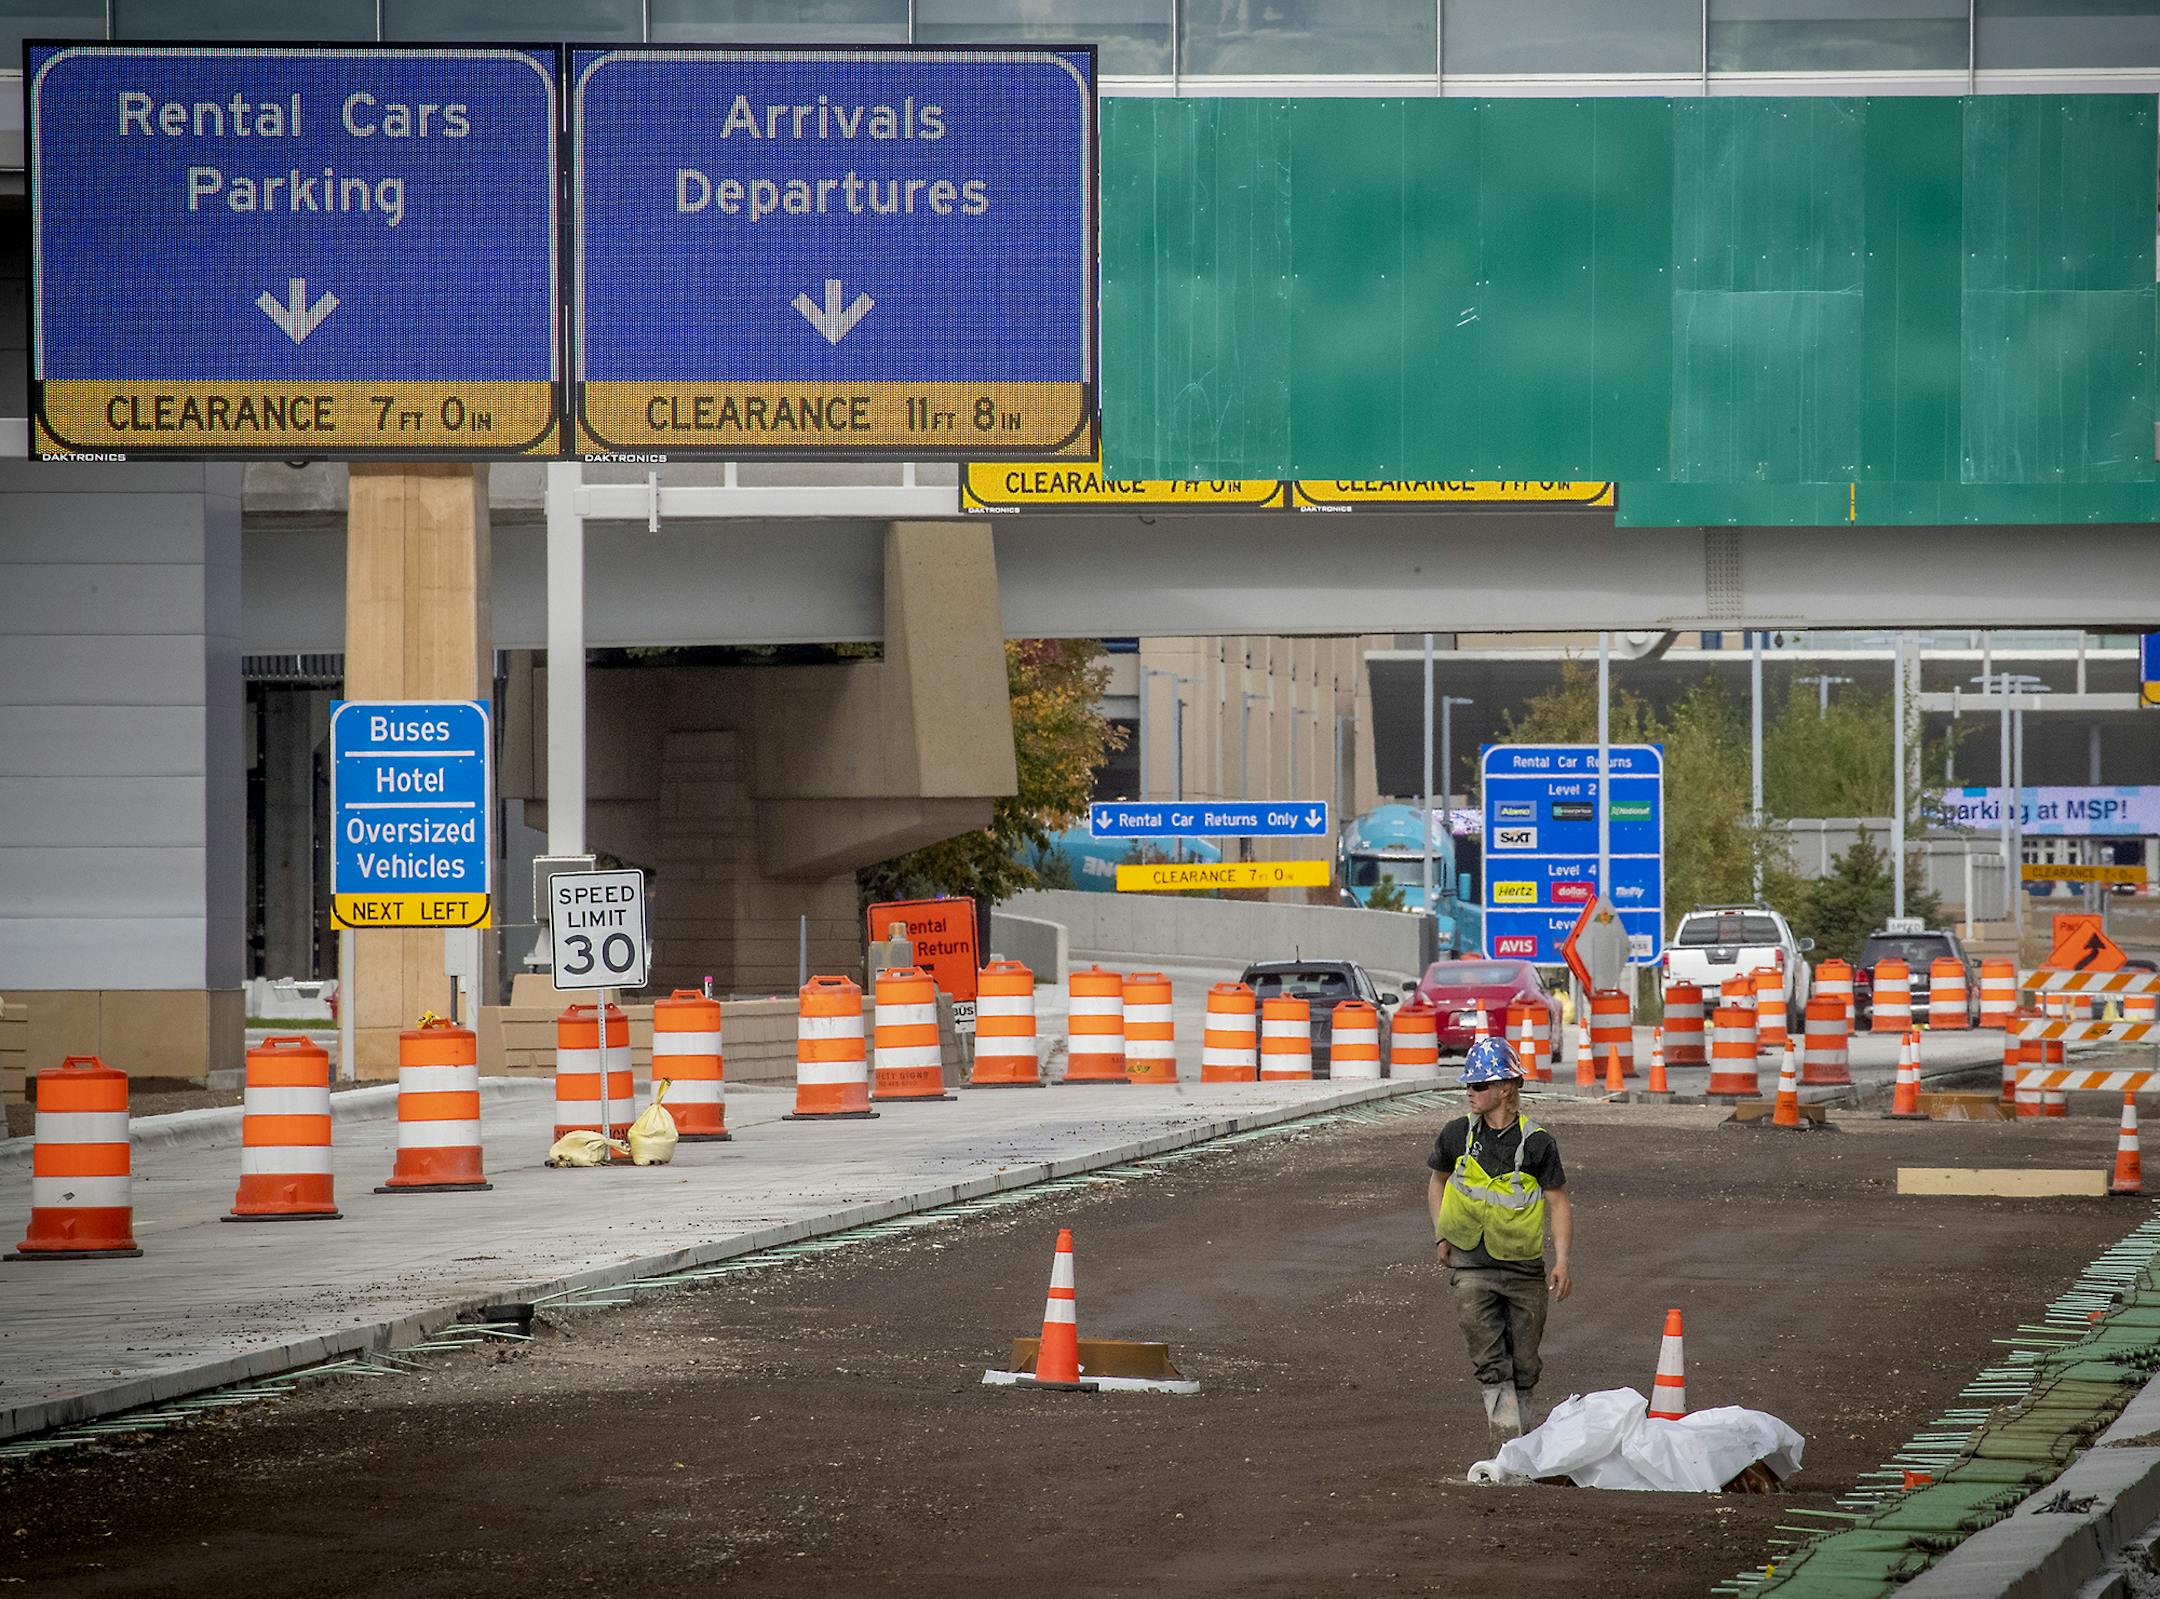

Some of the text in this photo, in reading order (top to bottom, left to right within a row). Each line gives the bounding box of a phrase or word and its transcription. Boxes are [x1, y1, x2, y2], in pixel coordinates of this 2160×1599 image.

[119, 91, 471, 138] Rental Cars
[720, 94, 946, 140] Arrivals
[187, 166, 405, 227] Parking
[675, 167, 989, 222] Departures
[106, 395, 334, 432] CLEARANCE
[646, 396, 870, 431] CLEARANCE
[42, 452, 126, 462] DAKTRONICS
[584, 454, 668, 463] DAKTRONICS
[370, 716, 450, 742] Buses
[1513, 756, 1633, 768] Rental Car Reurns
[376, 767, 445, 793] Hotel
[1548, 784, 1597, 796] Level 2
[2037, 803, 2059, 819] at
[2066, 800, 2127, 820] MSP!
[1119, 812, 1299, 829] Rental Car Returns Only
[346, 817, 476, 844] Oversized
[357, 853, 466, 879] Vehicles
[1548, 864, 1597, 877] Level 4
[2032, 867, 2096, 879] CLEARANCE
[1153, 869, 1236, 884] CLEARANCE
[559, 886, 635, 905] SPEED
[1498, 886, 1533, 897] Hertz
[353, 901, 470, 920] NEXT LEFT
[568, 909, 627, 928] LIMIT
[1549, 918, 1577, 930] Leve
[563, 932, 636, 976] 30
[918, 942, 969, 957] Return
[1500, 940, 1533, 953] AVIS
